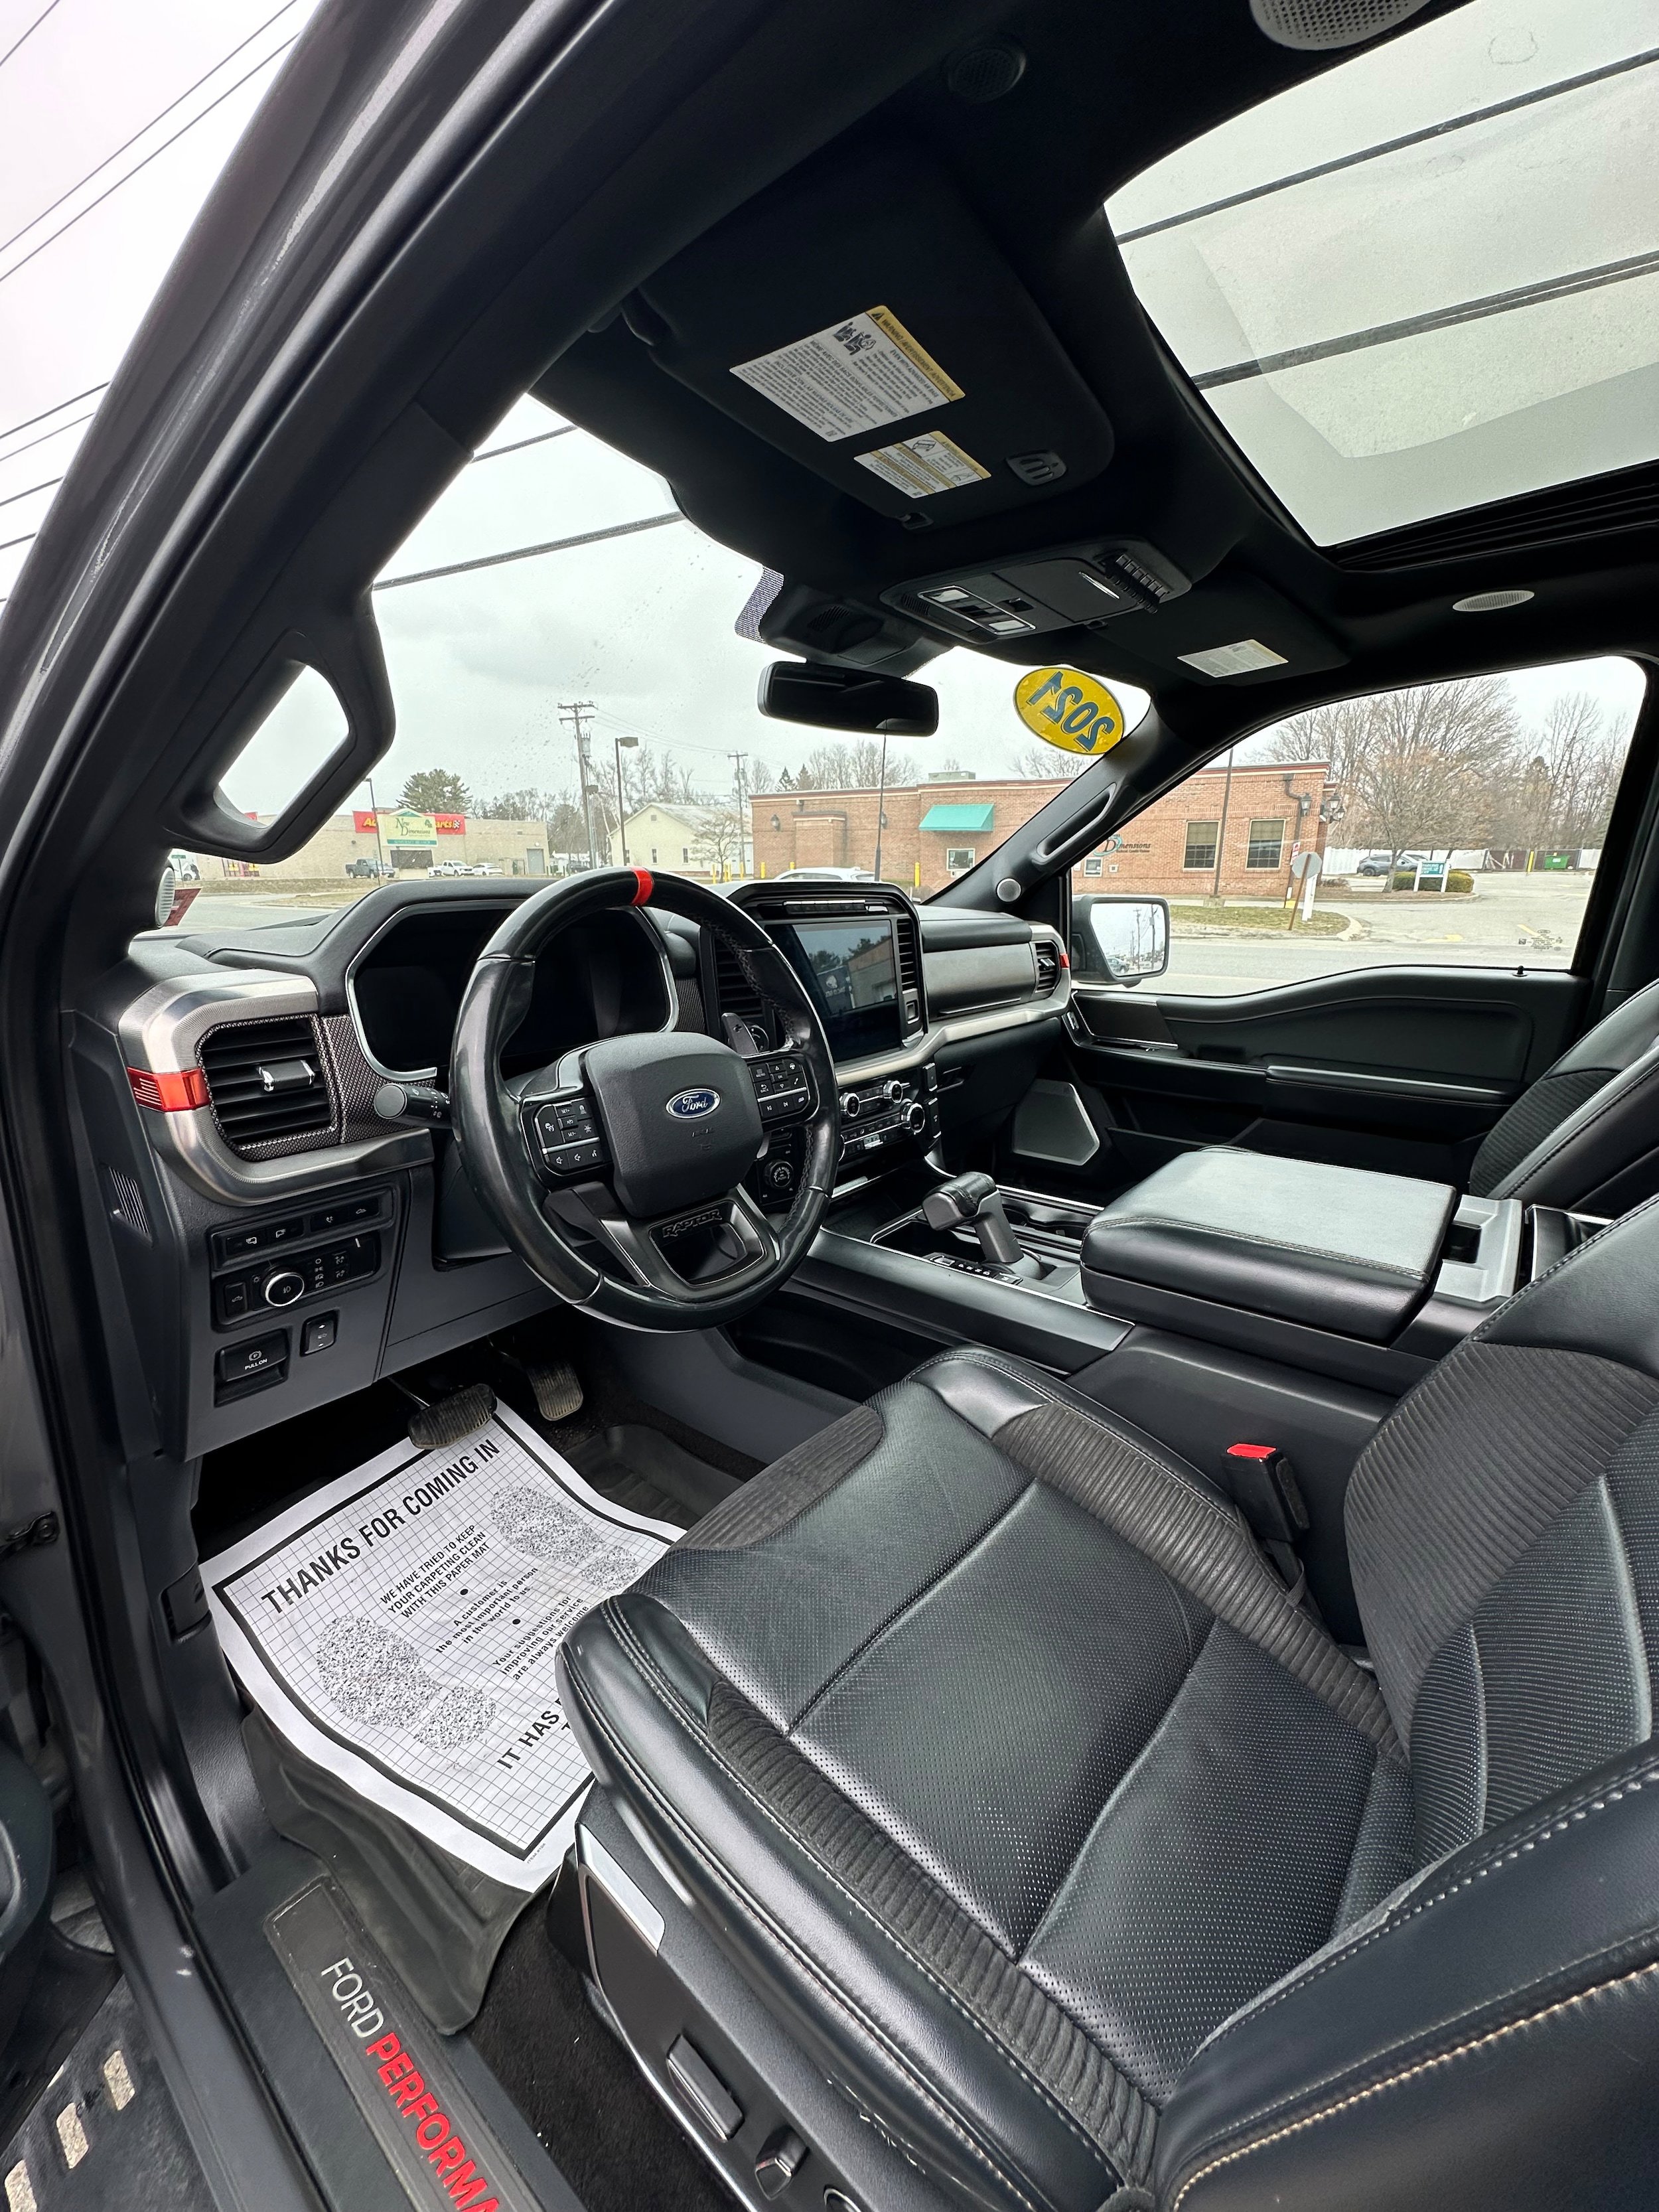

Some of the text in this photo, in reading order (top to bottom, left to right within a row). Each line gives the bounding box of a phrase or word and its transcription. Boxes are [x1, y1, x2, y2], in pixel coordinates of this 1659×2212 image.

[682, 1094, 709, 1112] Ford
[261, 1439, 500, 1614] THANKS FOR COMING IN
[380, 1524, 476, 1604] WE HAVE TRIED TO KEEP
[388, 1532, 486, 1614] YOUR CARPETING CLEAN
[401, 1541, 490, 1619] WITH THIS PAPER MAT
[435, 1568, 538, 1653] the most important person
[462, 1588, 498, 1619] customer
[462, 1635, 474, 1644] in
[472, 1622, 488, 1634] the
[487, 1602, 511, 1622] world
[492, 1649, 514, 1666] Your
[514, 1607, 560, 1649] suggestions
[500, 1598, 583, 1674] improving our service
[513, 1665, 528, 1680] are
[528, 1637, 557, 1665] always
[497, 1710, 559, 1769] IT HAS
[321, 1957, 384, 2038] FORD
